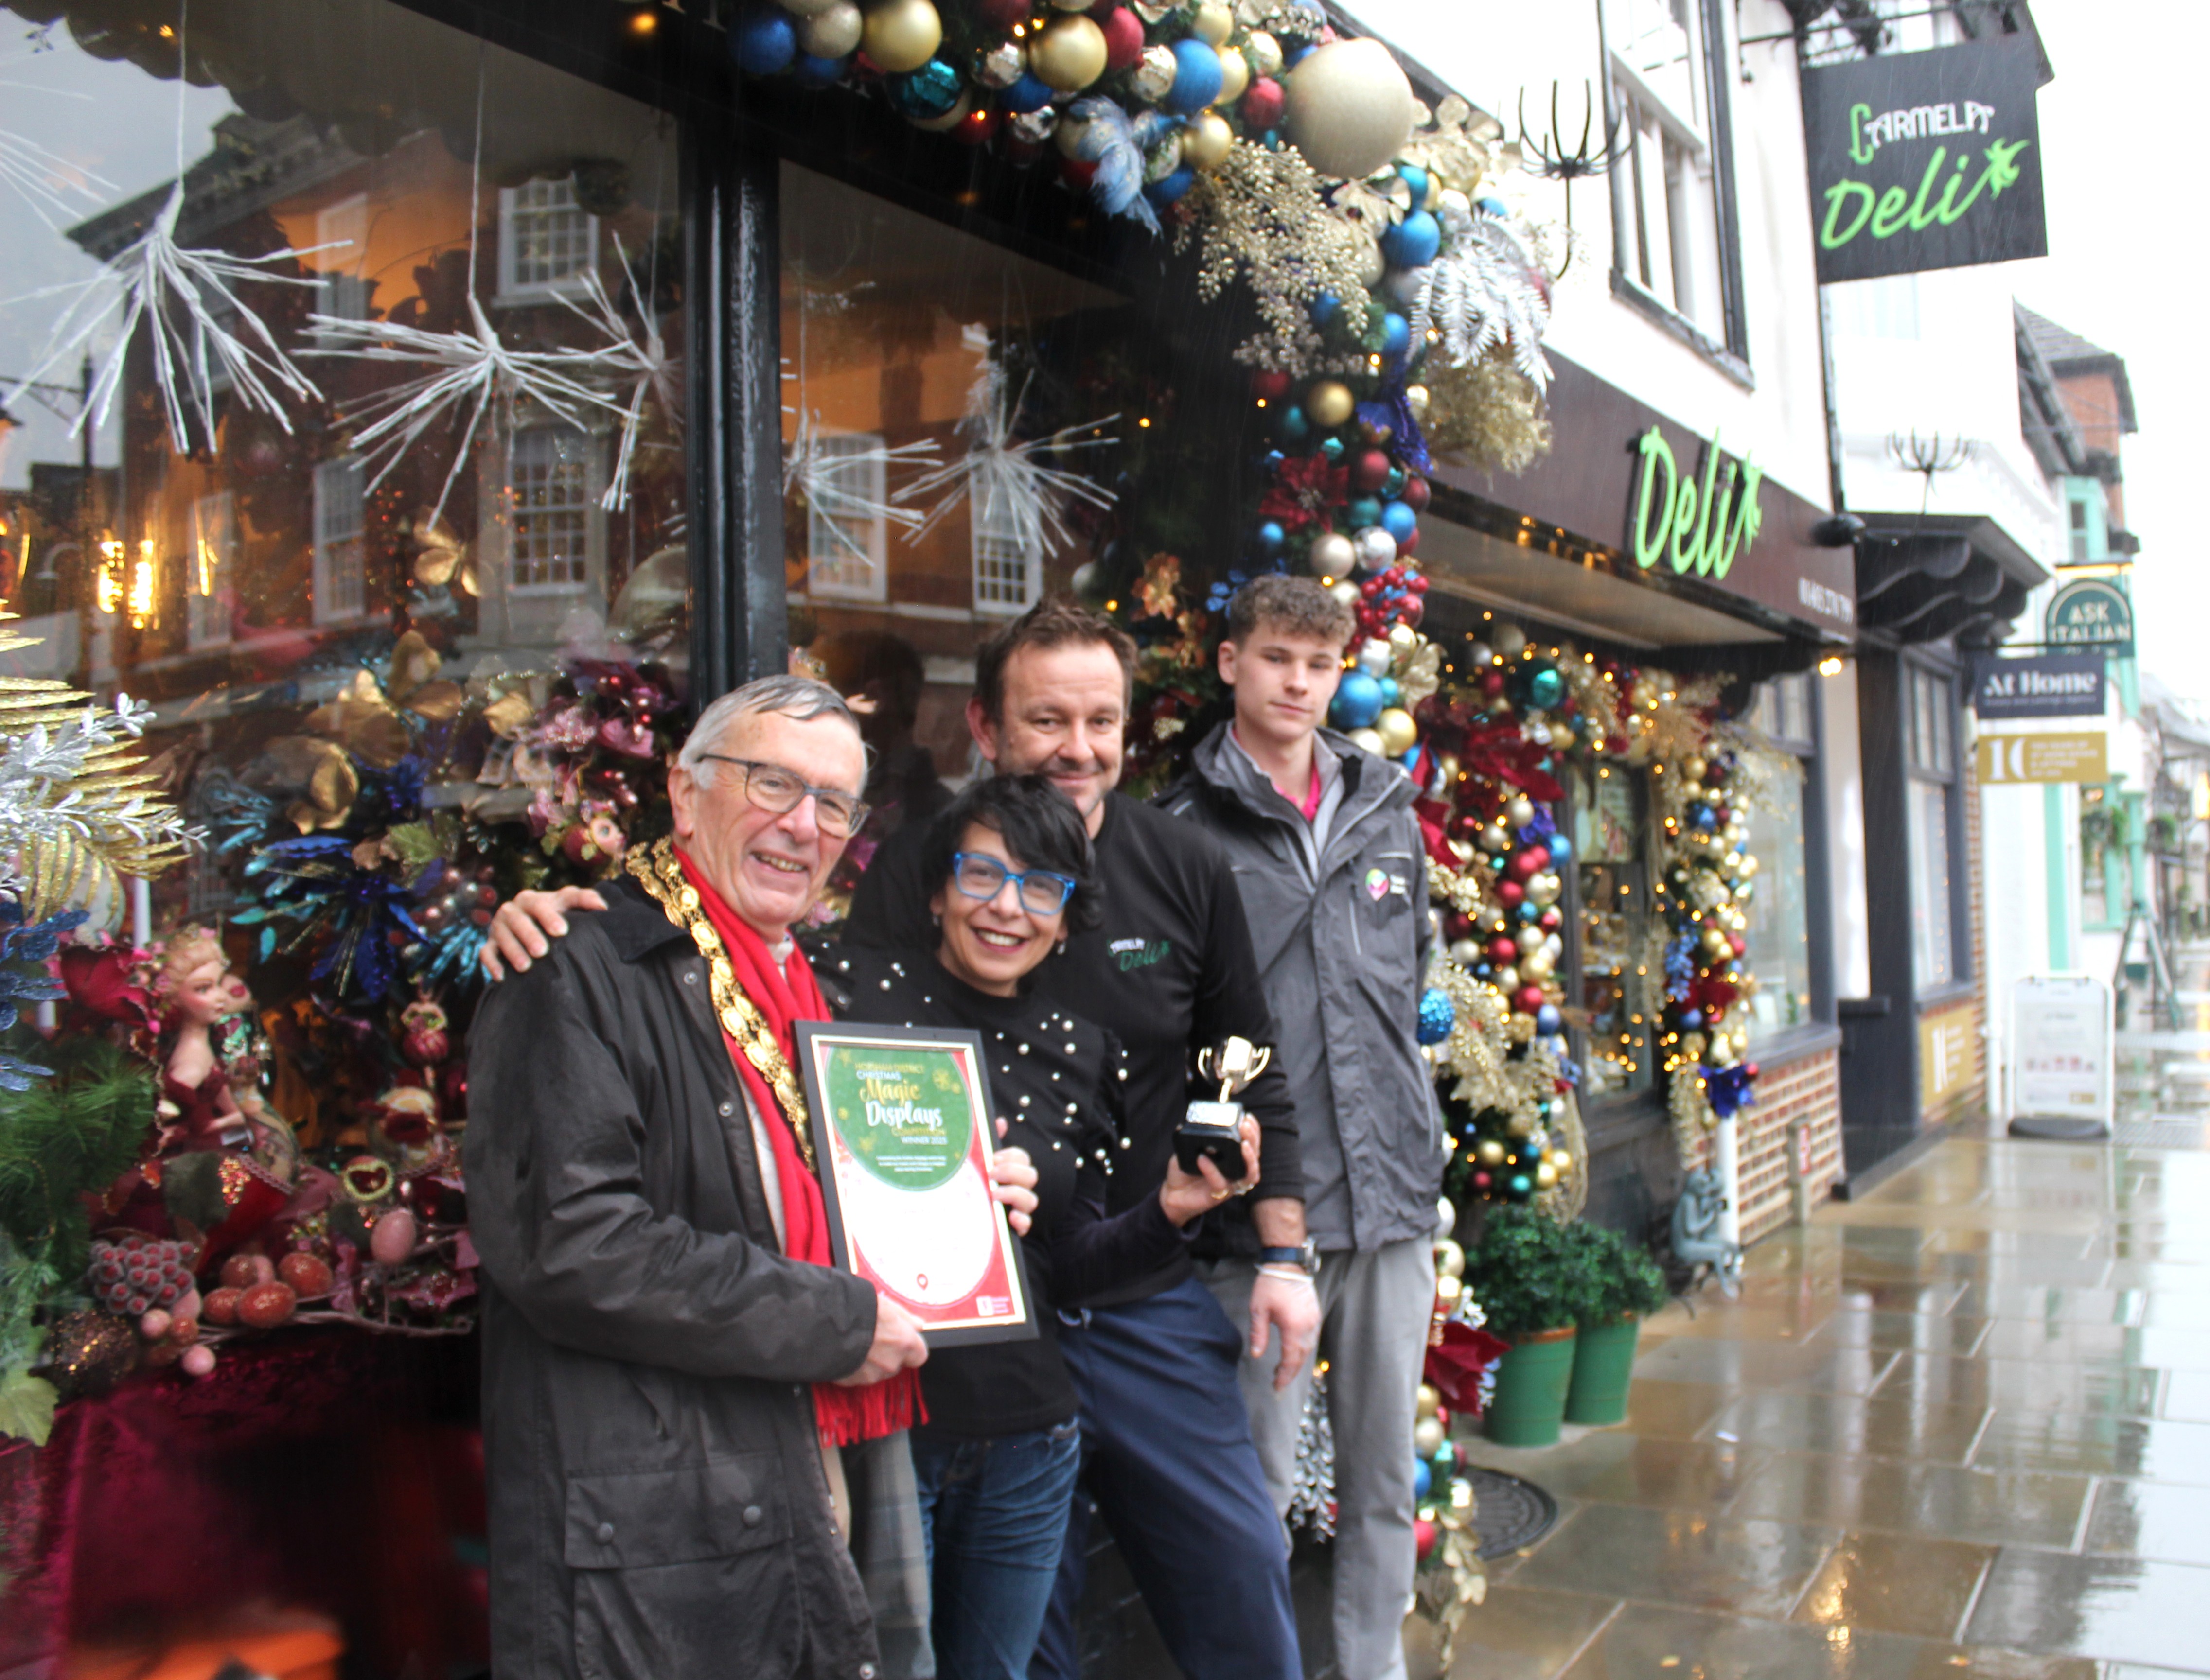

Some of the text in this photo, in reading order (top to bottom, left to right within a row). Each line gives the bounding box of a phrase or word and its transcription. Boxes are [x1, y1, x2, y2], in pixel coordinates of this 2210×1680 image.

[1848, 102, 1995, 165] CARMELA
[1820, 145, 1993, 250] Deli
[1634, 424, 1753, 581] Deli
[2069, 602, 2109, 624] ASK
[2048, 623, 2131, 644] ITALIAN
[1983, 670, 2097, 697] At Home
[856, 1070, 902, 1081] CHRISTMAS
[859, 1077, 921, 1107] Magic
[865, 1100, 943, 1131] Displays
